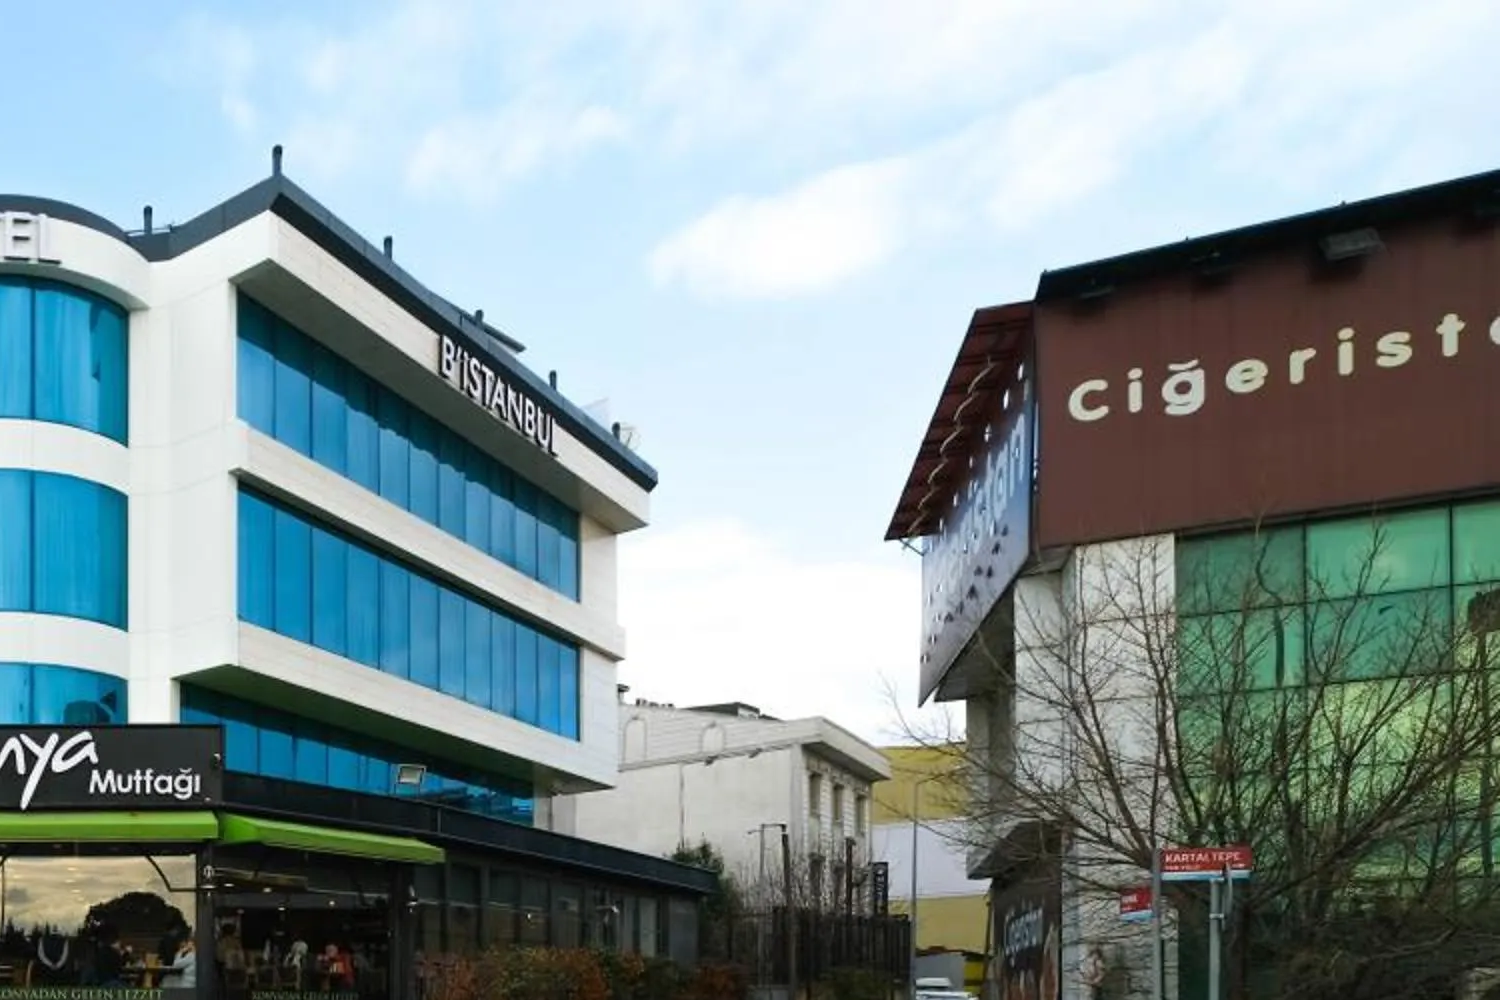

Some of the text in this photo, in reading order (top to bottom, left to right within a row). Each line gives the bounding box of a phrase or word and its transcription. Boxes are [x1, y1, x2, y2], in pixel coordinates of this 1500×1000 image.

[1067, 312, 1500, 421] Ciğerist
[89, 768, 201, 800] Mutfağı
[71, 987, 113, 1000] GELEN
[117, 987, 163, 1000] LEZZET
